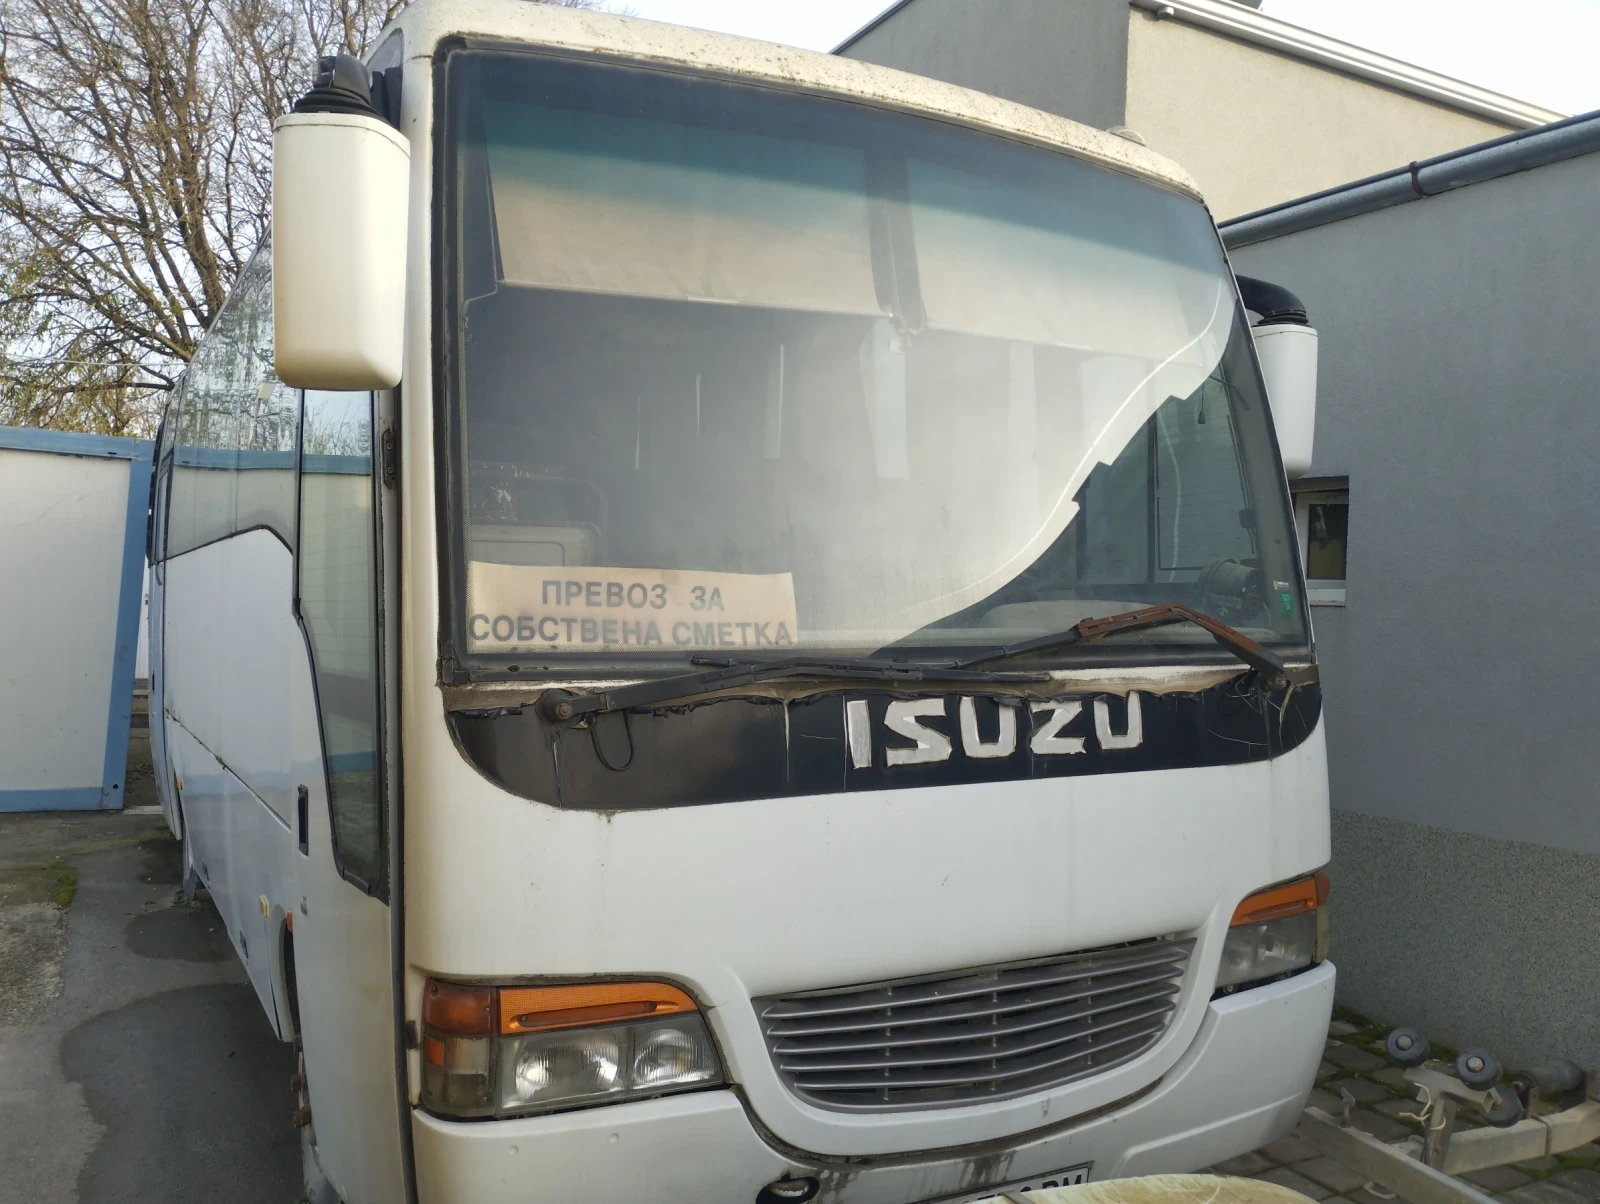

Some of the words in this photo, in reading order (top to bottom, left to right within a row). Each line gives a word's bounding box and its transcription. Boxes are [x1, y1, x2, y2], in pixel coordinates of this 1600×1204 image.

[542, 580, 667, 609] ПРЕВОЗ
[690, 586, 726, 611] ЗА
[470, 614, 663, 645] СОБСТВЕНА
[671, 621, 793, 646] СМЕТКА
[847, 690, 1143, 769] ISUZU
